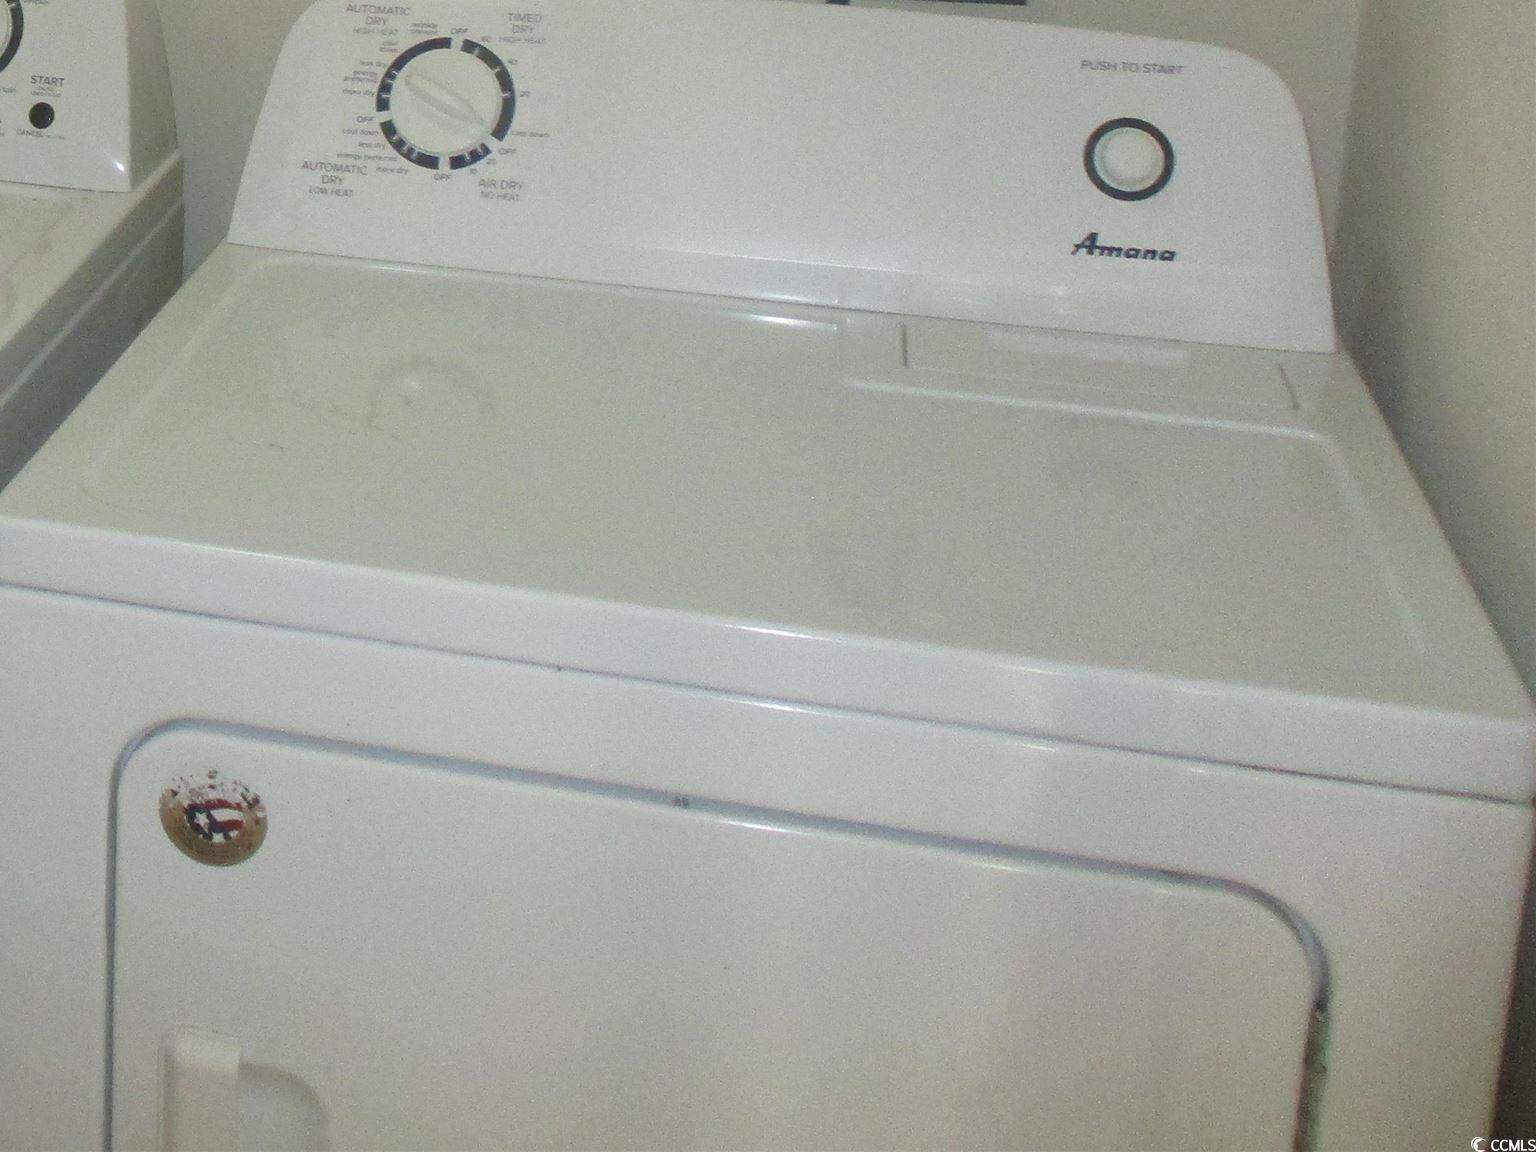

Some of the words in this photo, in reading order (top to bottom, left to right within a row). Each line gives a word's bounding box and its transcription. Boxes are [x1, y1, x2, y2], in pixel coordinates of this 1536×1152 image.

[346, 4, 411, 17] AUTOMATIC
[508, 12, 543, 24] TIMED
[1080, 59, 1117, 72] PUSH
[1121, 61, 1140, 73] TO
[1142, 62, 1185, 75] START
[30, 75, 65, 87] START
[301, 161, 368, 176] AUTOMATIC
[321, 175, 344, 186] DRY
[478, 179, 499, 190] AIR
[500, 180, 523, 191] DRY
[1070, 231, 1178, 262] Amana
